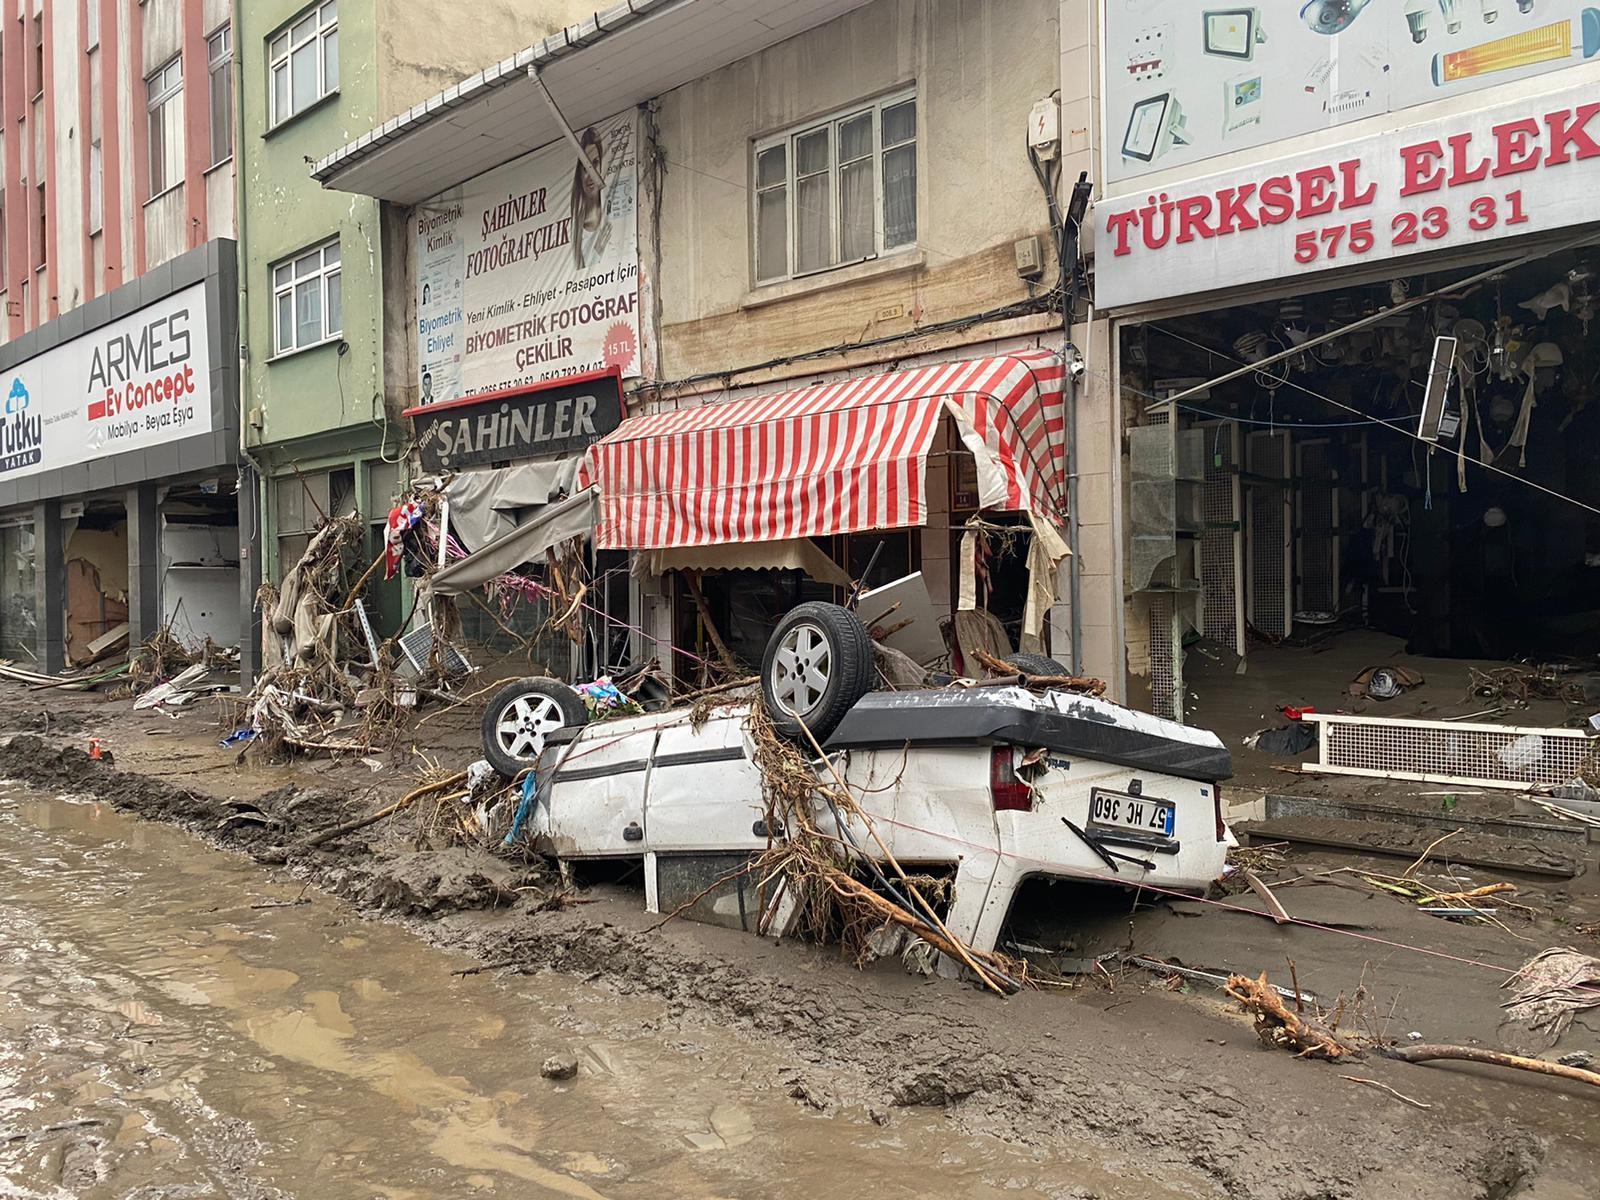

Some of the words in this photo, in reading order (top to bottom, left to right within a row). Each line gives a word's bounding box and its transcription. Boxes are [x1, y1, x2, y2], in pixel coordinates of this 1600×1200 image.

[1106, 158, 1378, 257] TÜRKSEL
[1399, 101, 1600, 198] ELEK
[418, 204, 462, 235] Biyometrik
[481, 187, 547, 242] ŞAHİNLER
[1294, 219, 1375, 264] 575
[1391, 206, 1449, 247] 23
[1468, 189, 1529, 232] 31
[427, 231, 454, 253] Kimlik
[465, 216, 573, 280] FOTOĞRAFÇILIK
[466, 310, 486, 325] Yeni
[486, 299, 515, 319] Kimlik
[522, 288, 557, 308] Ehliyet
[565, 273, 615, 296] Pasaport
[616, 263, 637, 281] İçin
[419, 307, 463, 335] Biyometrik
[466, 313, 547, 355] BİYOMETRİK
[551, 291, 638, 332] FOTOĞRAF
[88, 308, 191, 393] ARMES
[427, 332, 454, 354] Ehliyet
[516, 335, 574, 372] ÇEKİLİR
[608, 343, 618, 356] 15
[620, 341, 631, 353] TL
[106, 388, 122, 417] Ev
[125, 363, 195, 411] Concept
[0, 409, 42, 456] Tutku
[107, 420, 139, 440] Mobilya
[145, 412, 171, 431] Beyaz
[172, 405, 194, 428] Eşya
[5, 451, 35, 469] YATAK
[1094, 796, 1121, 821] 360
[1126, 801, 1143, 826] HC
[1149, 807, 1166, 829] 57
